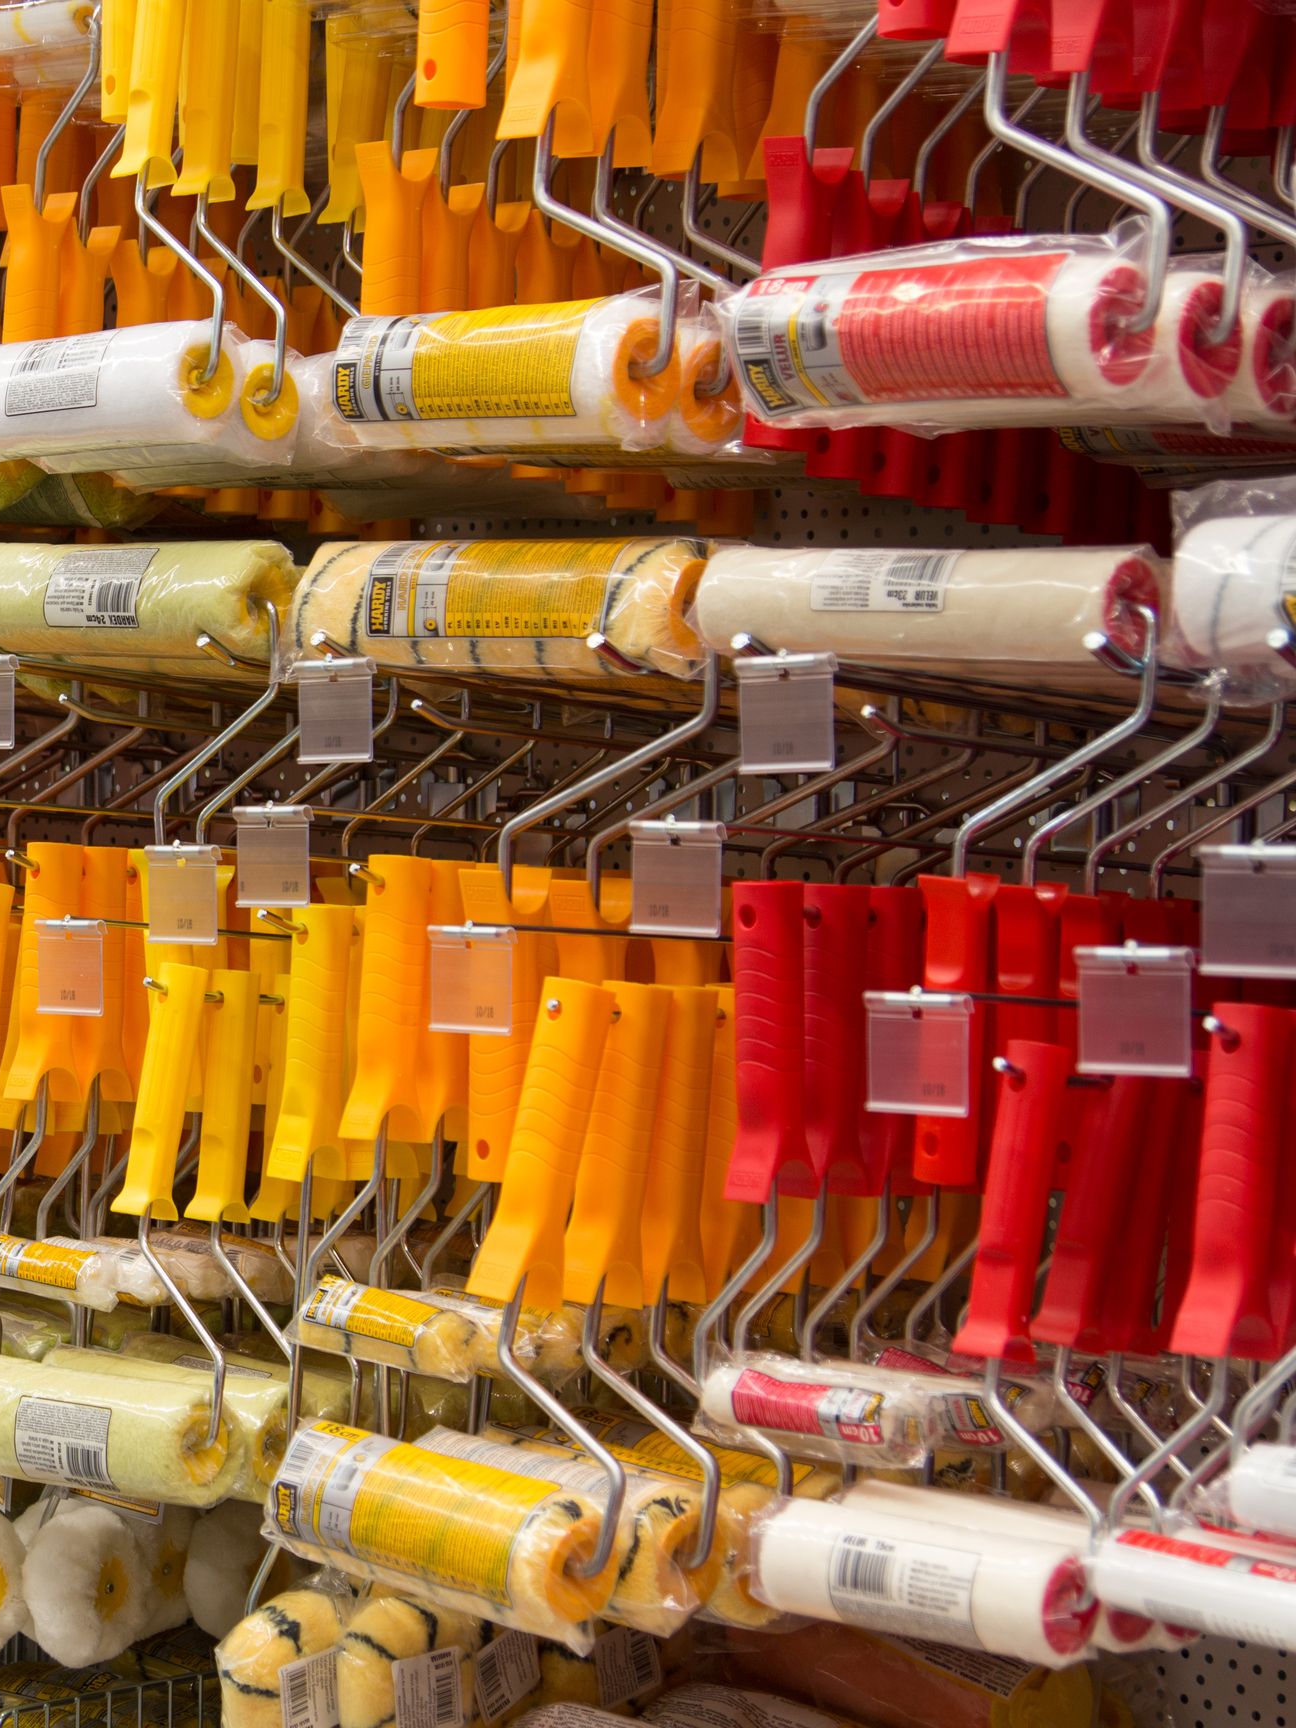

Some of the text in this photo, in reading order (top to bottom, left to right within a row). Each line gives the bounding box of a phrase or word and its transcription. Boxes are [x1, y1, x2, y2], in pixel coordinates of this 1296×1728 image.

[773, 334, 796, 381] VELUR
[337, 367, 355, 415] HARDY
[747, 363, 785, 408] HARDY
[371, 581, 386, 630] HARDY
[886, 590, 939, 601] VELUR 23cm
[85, 614, 137, 626] HARDEX 24cm
